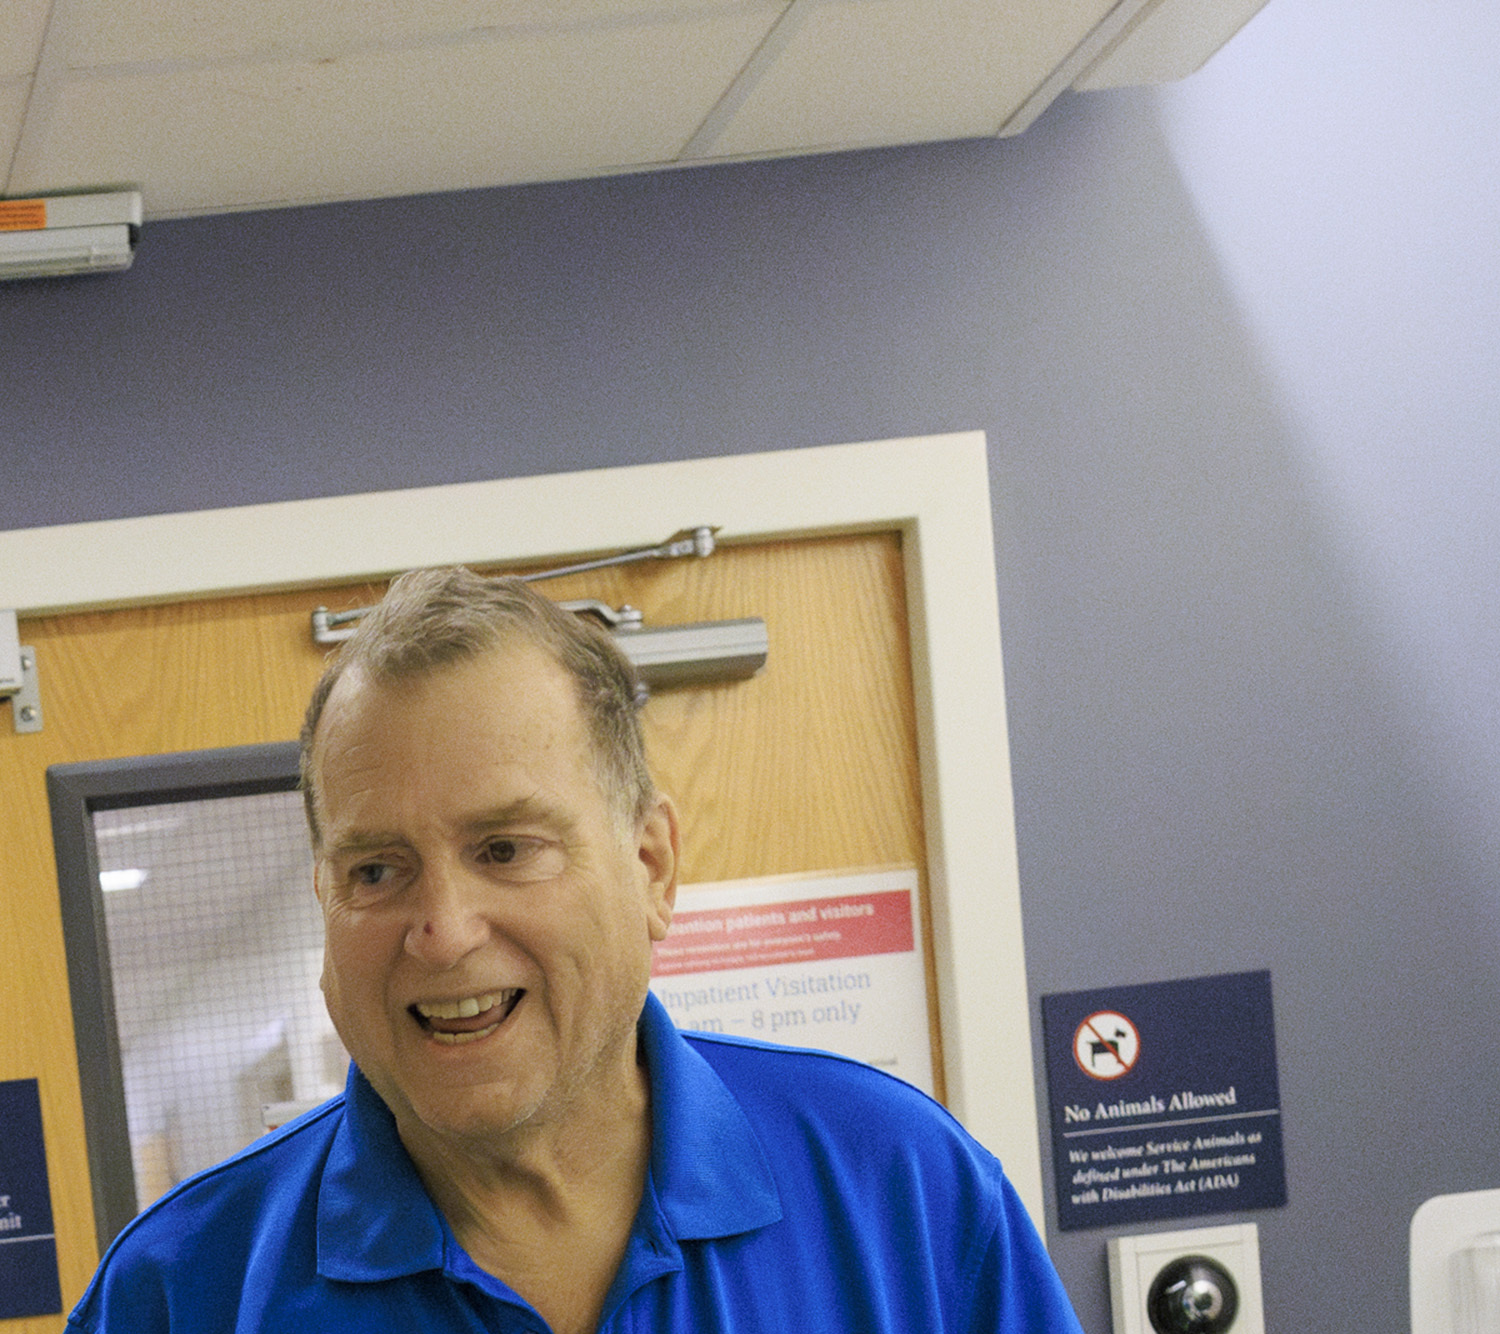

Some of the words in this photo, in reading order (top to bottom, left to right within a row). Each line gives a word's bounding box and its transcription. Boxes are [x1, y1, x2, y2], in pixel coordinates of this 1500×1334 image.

[726, 911, 786, 933] patients
[789, 906, 817, 924] and
[820, 902, 875, 920] visitors
[661, 981, 759, 1012] Inpatient
[765, 969, 871, 999] Visitation
[751, 1009, 764, 1029] 8
[771, 1007, 806, 1032] pm
[812, 999, 861, 1025] only
[1064, 1104, 1091, 1124] No
[1094, 1095, 1165, 1120] Animals
[1168, 1086, 1237, 1112] Allowed
[1068, 1150, 1089, 1163] We
[1091, 1144, 1144, 1161] welcome
[1145, 1139, 1190, 1156] Service
[1192, 1131, 1246, 1150] Animals
[1247, 1132, 1262, 1144] as
[1072, 1166, 1120, 1186] defined
[1122, 1162, 1159, 1179] under
[1162, 1158, 1187, 1174] The
[1188, 1153, 1256, 1171] Americans
[1071, 1189, 1100, 1205] with
[1102, 1182, 1172, 1202] Disabilities
[1174, 1179, 1197, 1194] Act
[1198, 1173, 1240, 1192] (ADA)
